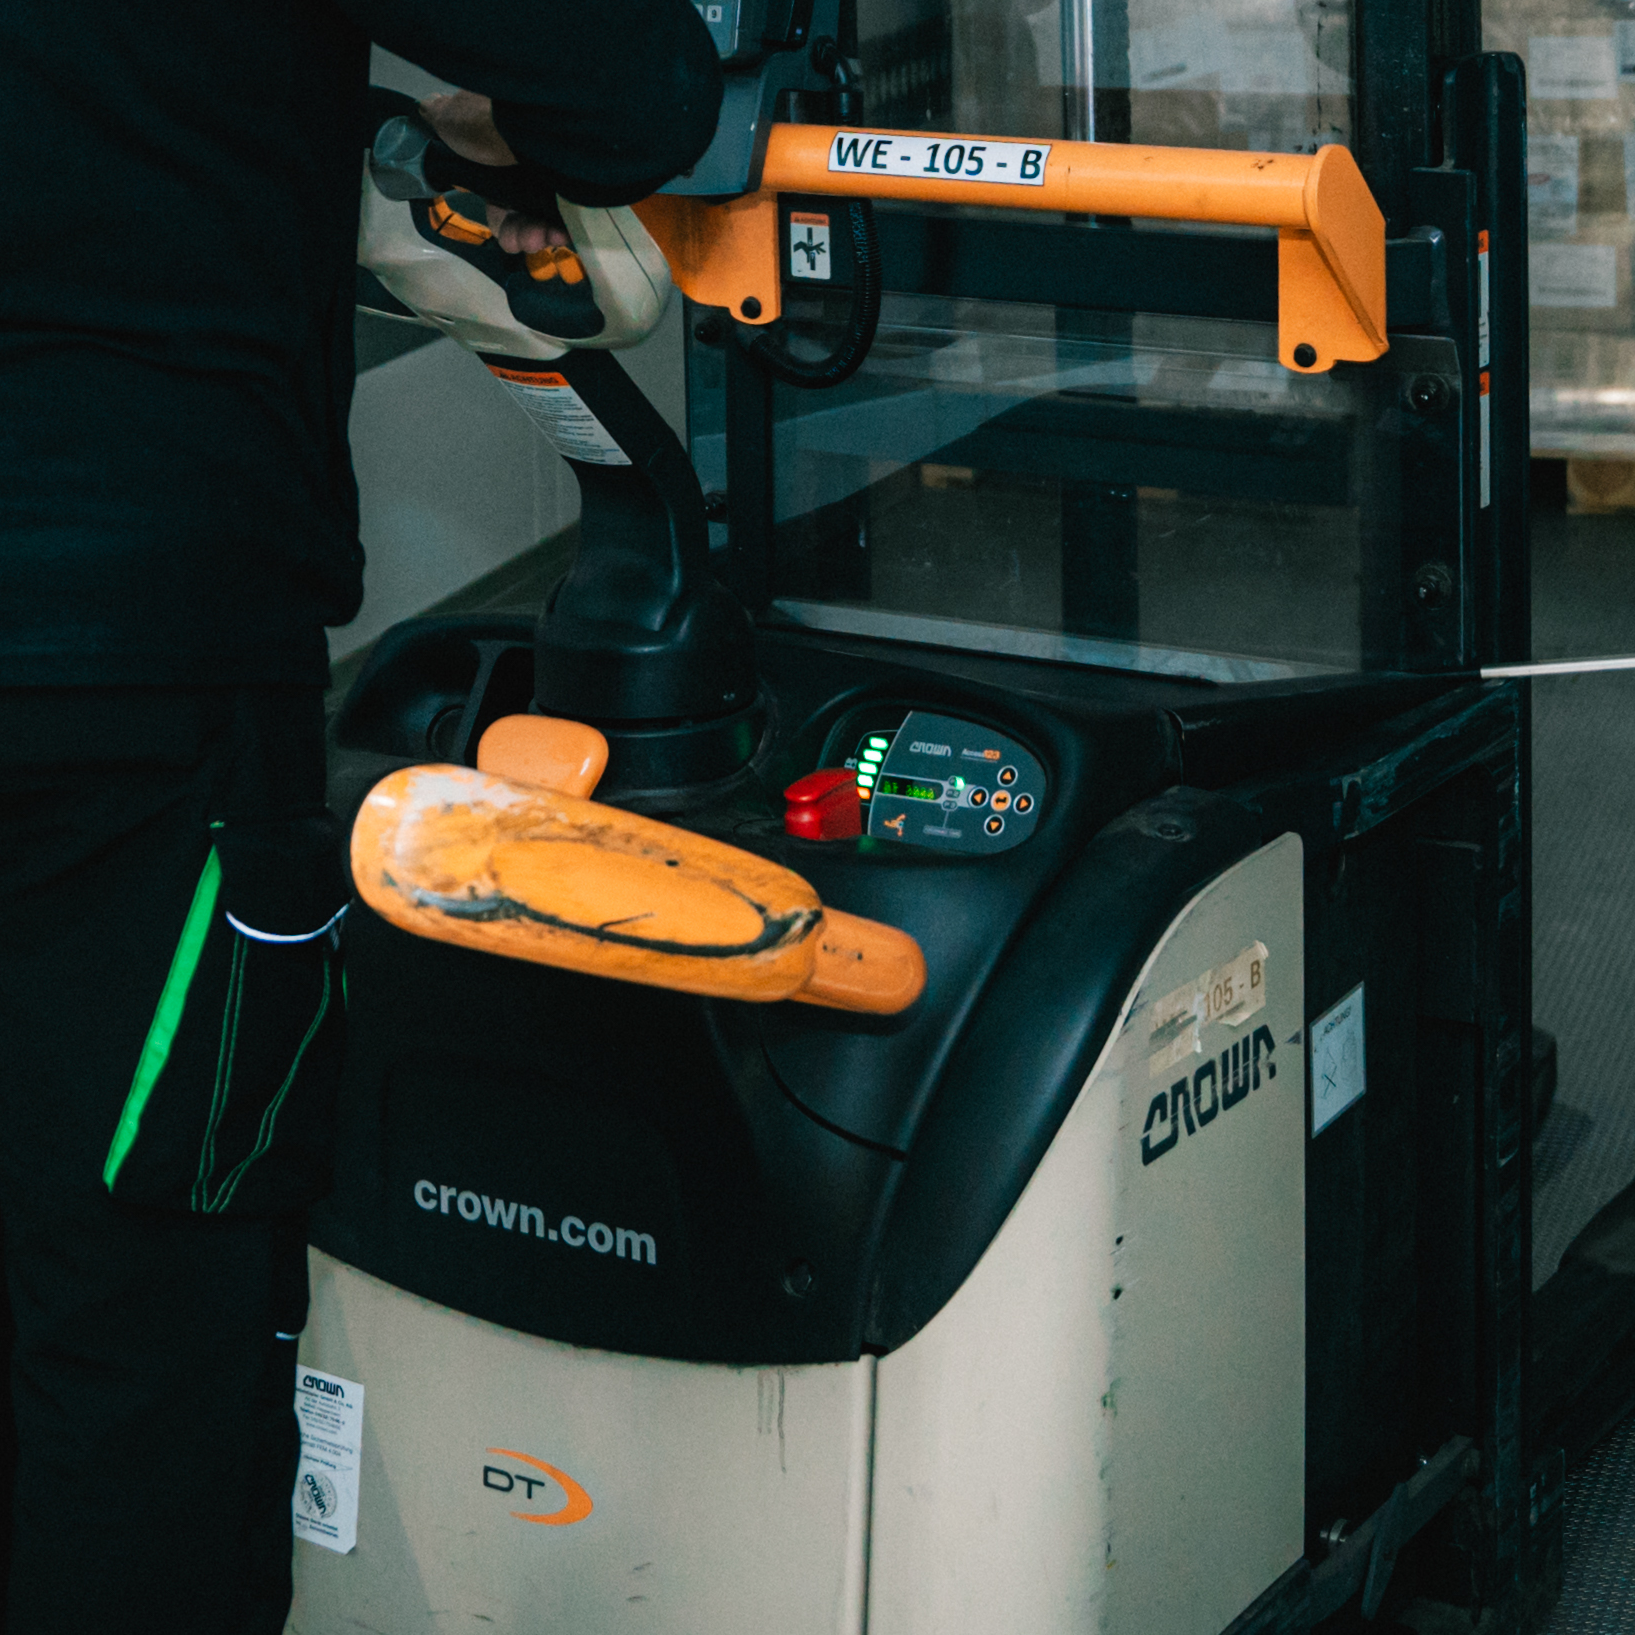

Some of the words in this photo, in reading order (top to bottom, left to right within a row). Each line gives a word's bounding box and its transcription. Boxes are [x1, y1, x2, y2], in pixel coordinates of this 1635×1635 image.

[837, 136, 893, 169] WE
[923, 143, 987, 176] 105
[1019, 149, 1043, 180] B
[909, 741, 953, 757] CROWN
[1205, 976, 1234, 1016] 105
[1250, 959, 1262, 990] B
[1140, 1023, 1278, 1167] CROWN
[413, 1179, 657, 1265] crown.com
[303, 1374, 345, 1399] CROWN
[483, 1465, 546, 1500] DT
